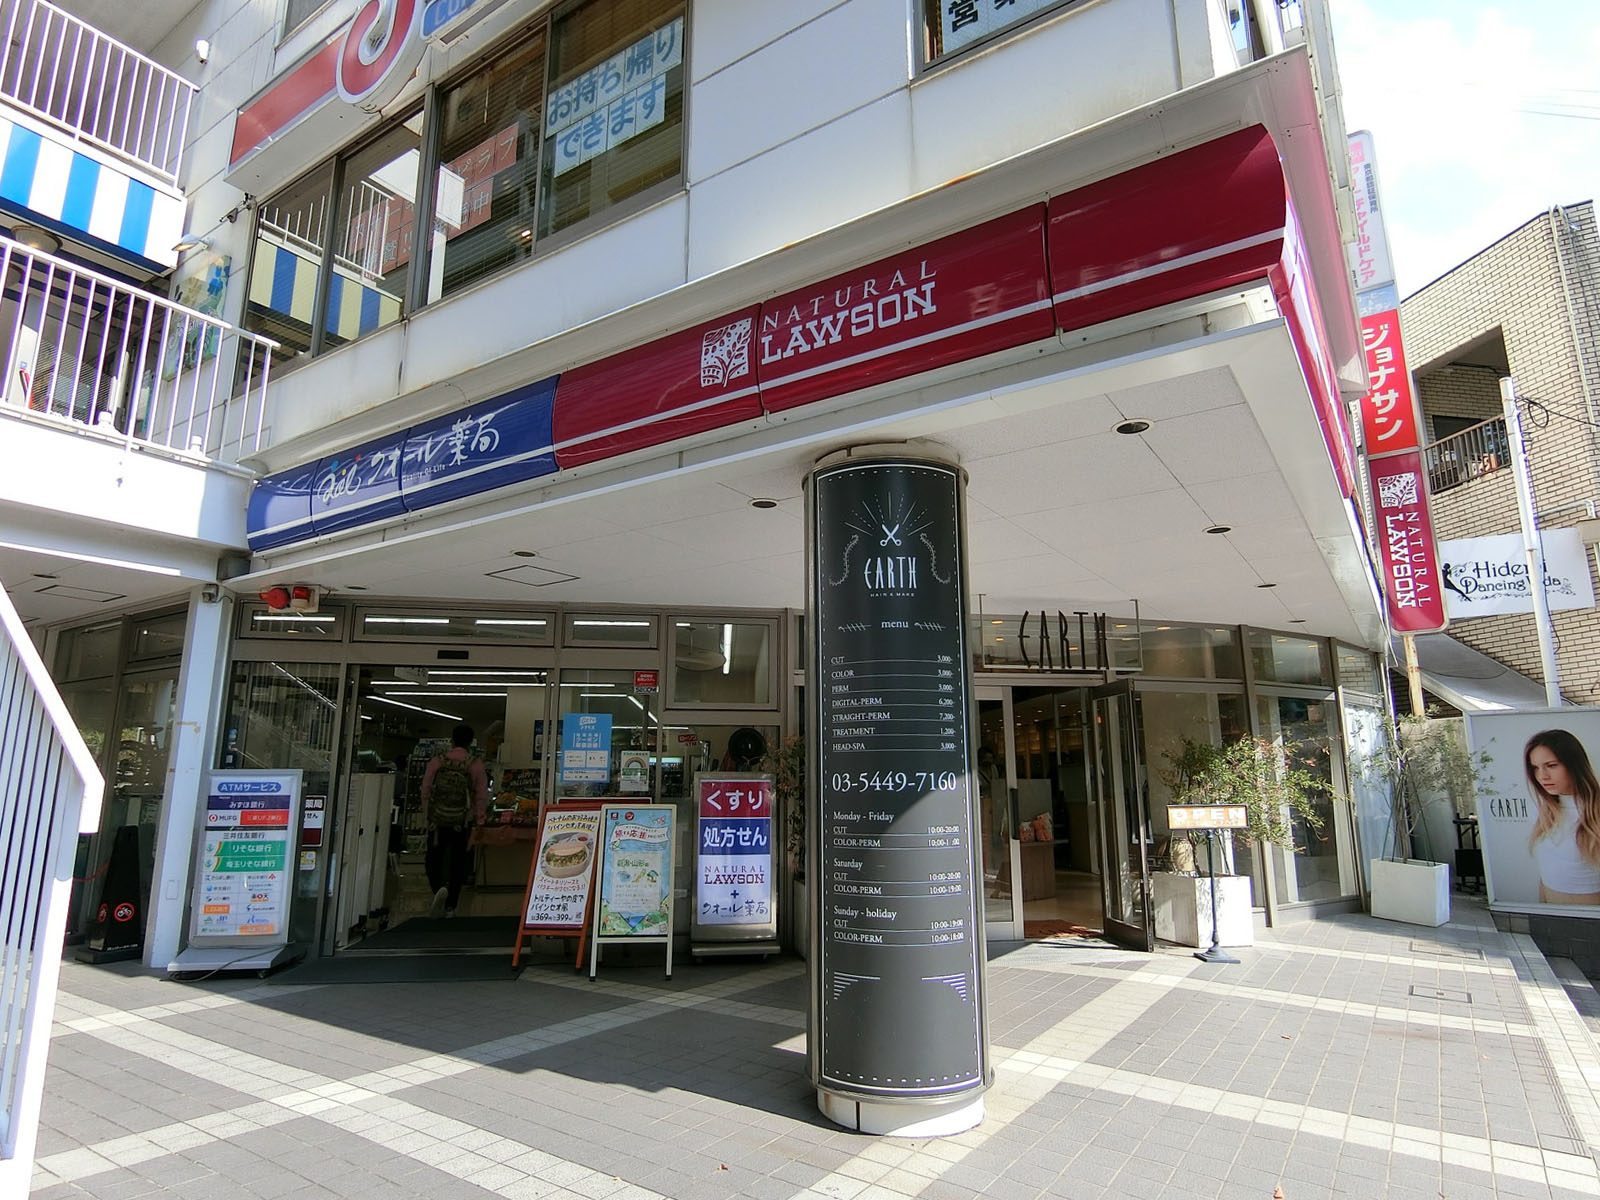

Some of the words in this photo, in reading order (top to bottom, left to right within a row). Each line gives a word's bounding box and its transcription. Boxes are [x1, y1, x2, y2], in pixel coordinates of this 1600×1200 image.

[948, 0, 1016, 33] 営
[549, 28, 675, 126] お持ち帰り
[557, 82, 666, 160] できます
[762, 260, 937, 332] NATURAL
[761, 281, 937, 365] LAWSON
[1363, 323, 1403, 441] ジョナサン
[368, 413, 500, 486] クオール薬局
[1385, 515, 1417, 609] LAWSON
[1406, 511, 1432, 608] NATURAL
[864, 556, 918, 589] EARTH
[1473, 559, 1548, 579] Hidei
[1459, 576, 1527, 595] Dancing
[881, 620, 909, 629] menu
[1017, 610, 1110, 670] EARTH
[831, 656, 845, 665] CUT
[831, 670, 854, 678] COLOR
[831, 685, 849, 693] PERM
[832, 697, 883, 707] DIGITAL-PERM
[832, 711, 891, 722] STRAIGHT-PERM
[832, 727, 876, 736] TREATMENT
[832, 742, 866, 751] HEAD-SPA
[832, 770, 957, 793] 03-5449-7160
[220, 784, 278, 792] ATMサービス
[229, 801, 266, 809] みずほ銀行
[707, 789, 763, 811] くすり
[1172, 807, 1246, 821] OPEN
[1490, 798, 1529, 818] EARTH
[833, 811, 861, 822] Monday
[868, 811, 895, 823] Friday
[223, 832, 265, 840] 三井住友銀行
[833, 826, 848, 834] CUT
[703, 826, 767, 848] 処方せん
[833, 838, 881, 847] COLOR-PERM
[927, 837, 960, 847] 10:00-1:00
[232, 844, 273, 853] りそな銀行
[704, 865, 765, 873] NATURAL
[833, 857, 863, 870] Saturday
[704, 873, 765, 885] LAWSON
[833, 872, 848, 881] CUT
[833, 885, 882, 895] COLOR-PERM
[702, 899, 768, 917] クオール薬局
[833, 904, 859, 918] Sunday
[866, 907, 898, 920] holiday
[833, 918, 848, 928] CUT
[833, 931, 883, 943] COLOR-PERM
